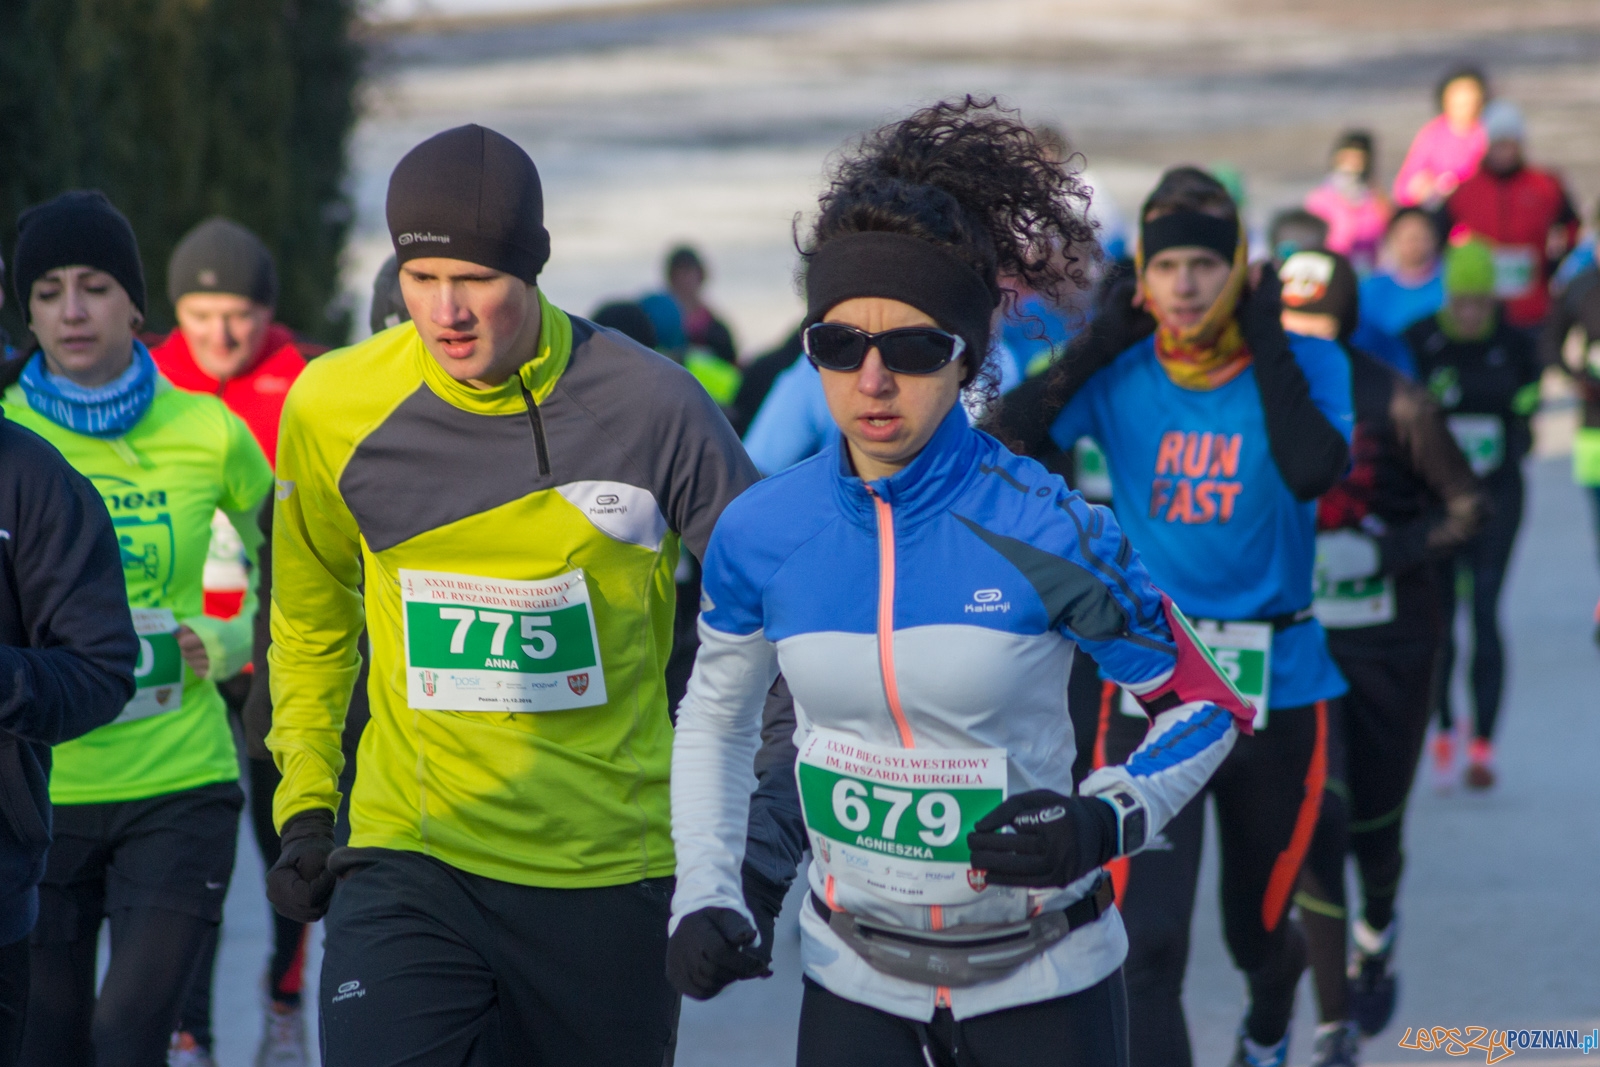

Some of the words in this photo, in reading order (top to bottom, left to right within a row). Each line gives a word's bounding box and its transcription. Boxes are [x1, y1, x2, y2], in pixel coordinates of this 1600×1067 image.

[413, 232, 450, 244] Kalenji
[1154, 430, 1243, 478] RUN
[589, 505, 628, 515] Kalenji
[1149, 478, 1244, 524] FAST
[424, 577, 455, 590] XXXII
[457, 579, 483, 592] BIEG
[484, 580, 571, 598] SYLWESTROWY
[431, 590, 449, 600] IM.
[451, 591, 508, 607] RYSZARDA
[509, 595, 570, 610] BURGIELA
[964, 602, 1011, 613] Kalenji
[439, 607, 558, 660] 775
[484, 657, 520, 670] ANNA
[824, 739, 855, 758] XXXII
[856, 746, 882, 766] BIEG
[884, 756, 990, 770] SYLWESTROWY
[826, 754, 842, 769] IM.
[844, 761, 910, 784] RYSZARDA
[912, 772, 984, 786] BURGIELA
[831, 778, 962, 848] 679
[855, 834, 935, 860] AGNIESZKA
[332, 988, 366, 1004] Kalenji
